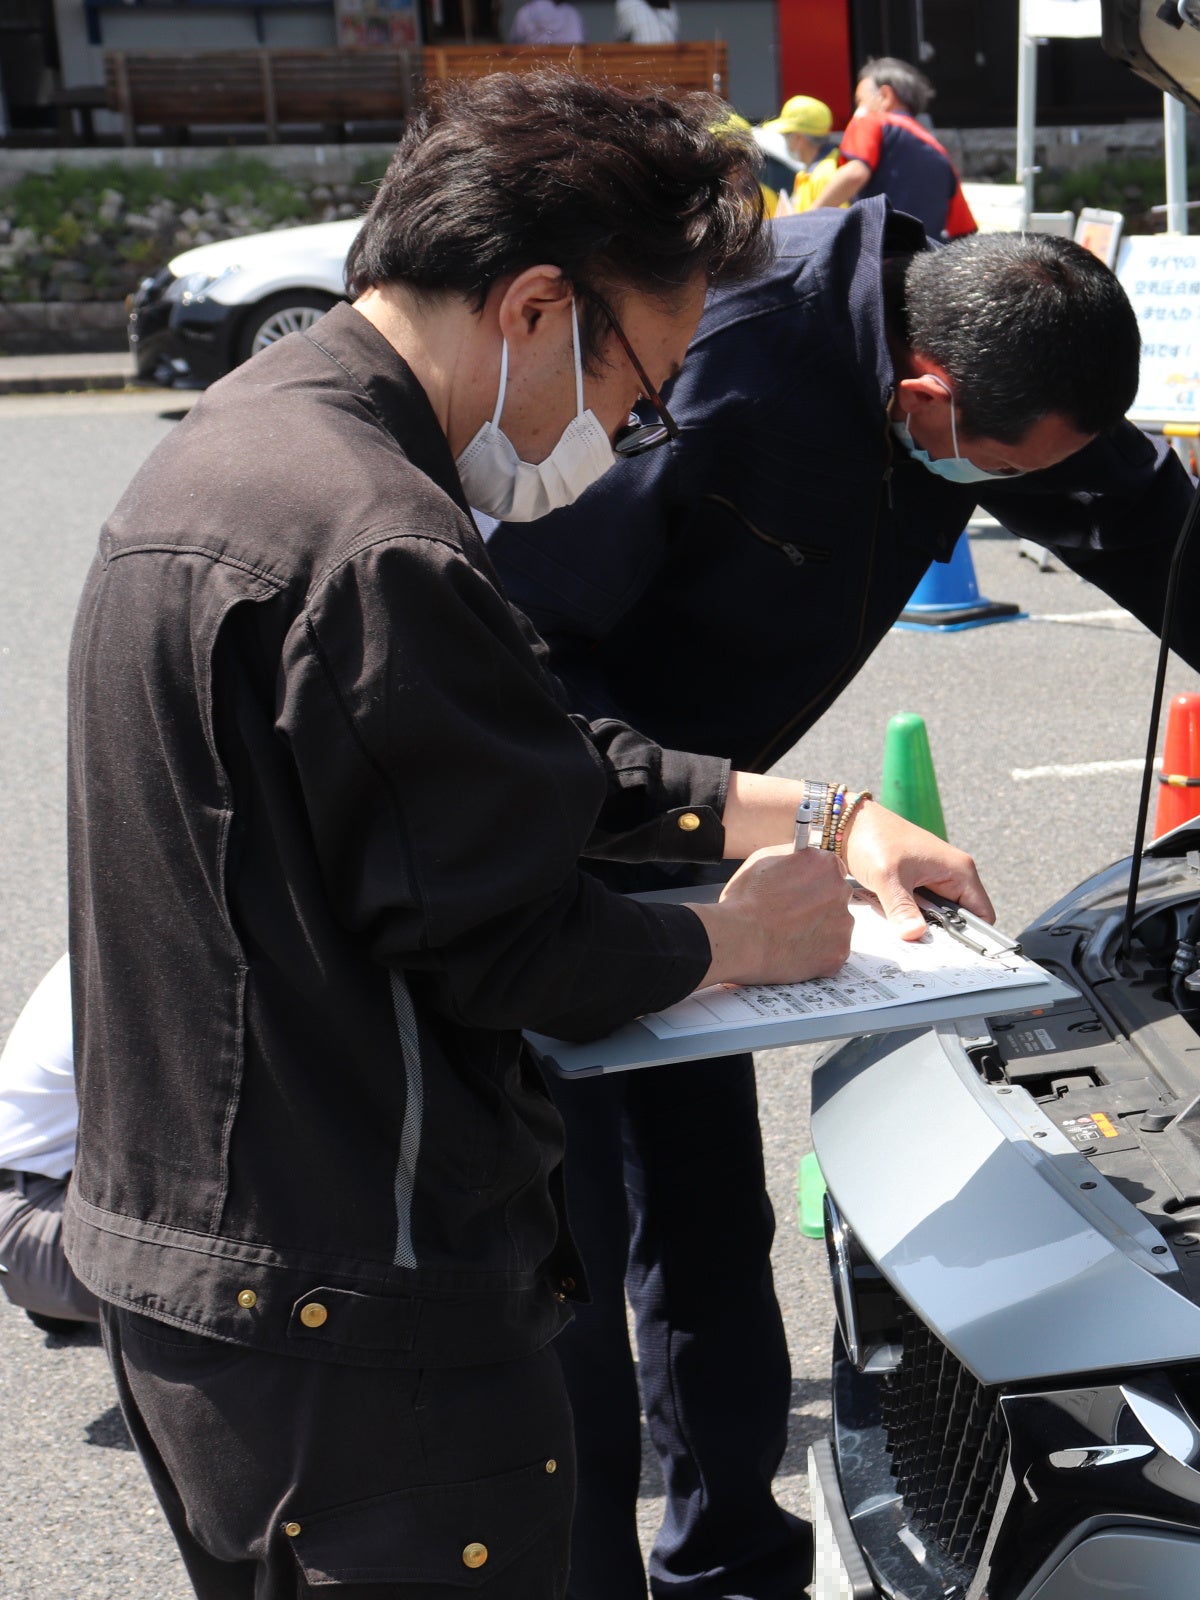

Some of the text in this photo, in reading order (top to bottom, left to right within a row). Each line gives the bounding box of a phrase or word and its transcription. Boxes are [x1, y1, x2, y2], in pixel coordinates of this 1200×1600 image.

[1148, 255, 1197, 271] タイヤの
[1135, 280, 1200, 295] 空気圧点検
